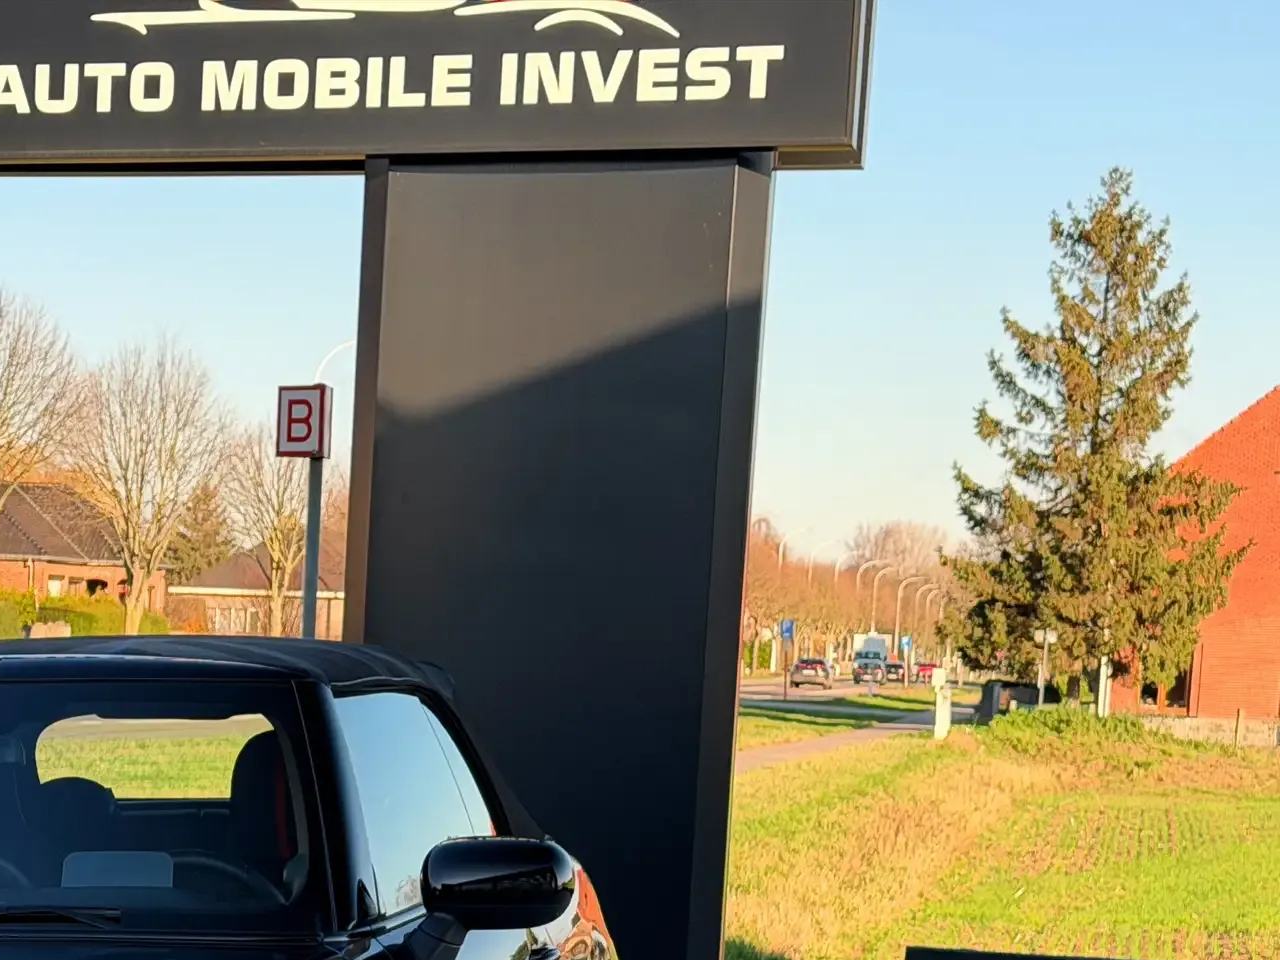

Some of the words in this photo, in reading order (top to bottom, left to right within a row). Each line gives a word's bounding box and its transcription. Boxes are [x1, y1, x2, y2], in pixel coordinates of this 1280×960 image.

[200, 53, 473, 112] MOBILE
[499, 44, 786, 106] INVEST
[286, 398, 313, 443] B
